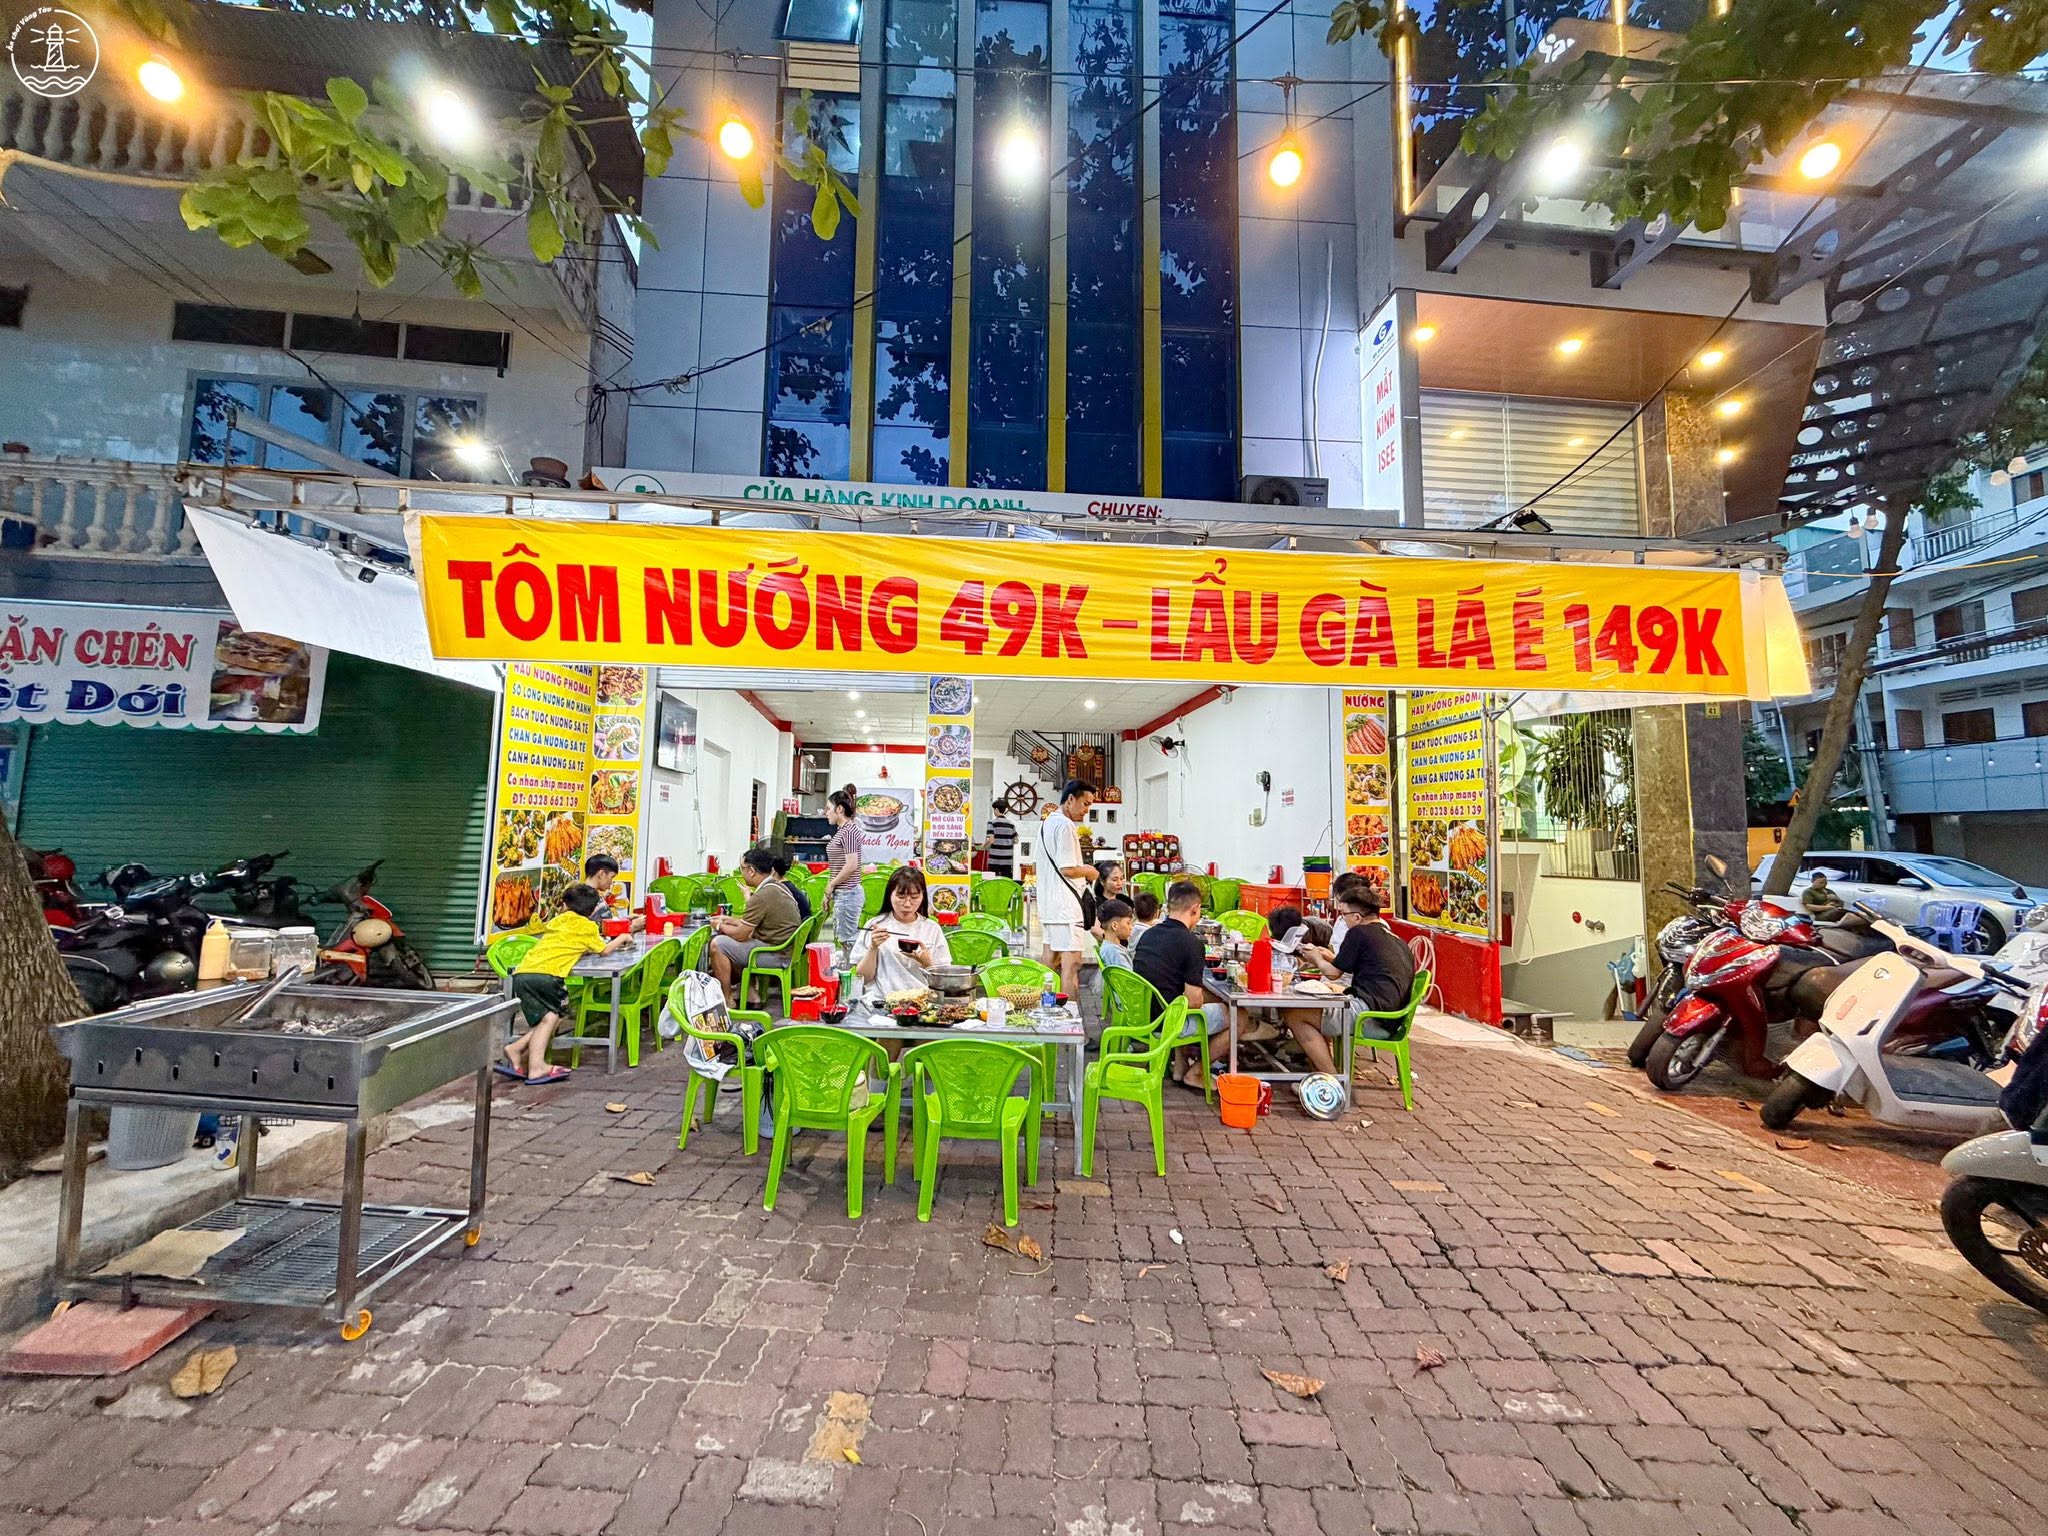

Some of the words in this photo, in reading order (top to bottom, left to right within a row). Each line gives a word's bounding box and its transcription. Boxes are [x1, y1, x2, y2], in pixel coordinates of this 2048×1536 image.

[1378, 440, 1395, 473] ISEE
[448, 542, 621, 653] TÔM
[643, 556, 919, 656] NƯỚNG
[939, 580, 1089, 660] 49K
[1150, 557, 1279, 666] LẨU
[1298, 579, 1398, 668] GÀ
[1416, 584, 1498, 670] LÁ
[1512, 588, 1547, 671] É
[1563, 604, 1729, 676] 149K
[75, 622, 194, 670] CHÉN
[66, 680, 186, 717] Đới
[528, 793, 548, 806] 0328
[549, 795, 564, 807] 662
[565, 796, 579, 808] 139
[1430, 806, 1448, 816] 0328
[1449, 805, 1465, 816] 662
[1467, 805, 1482, 816] 139
